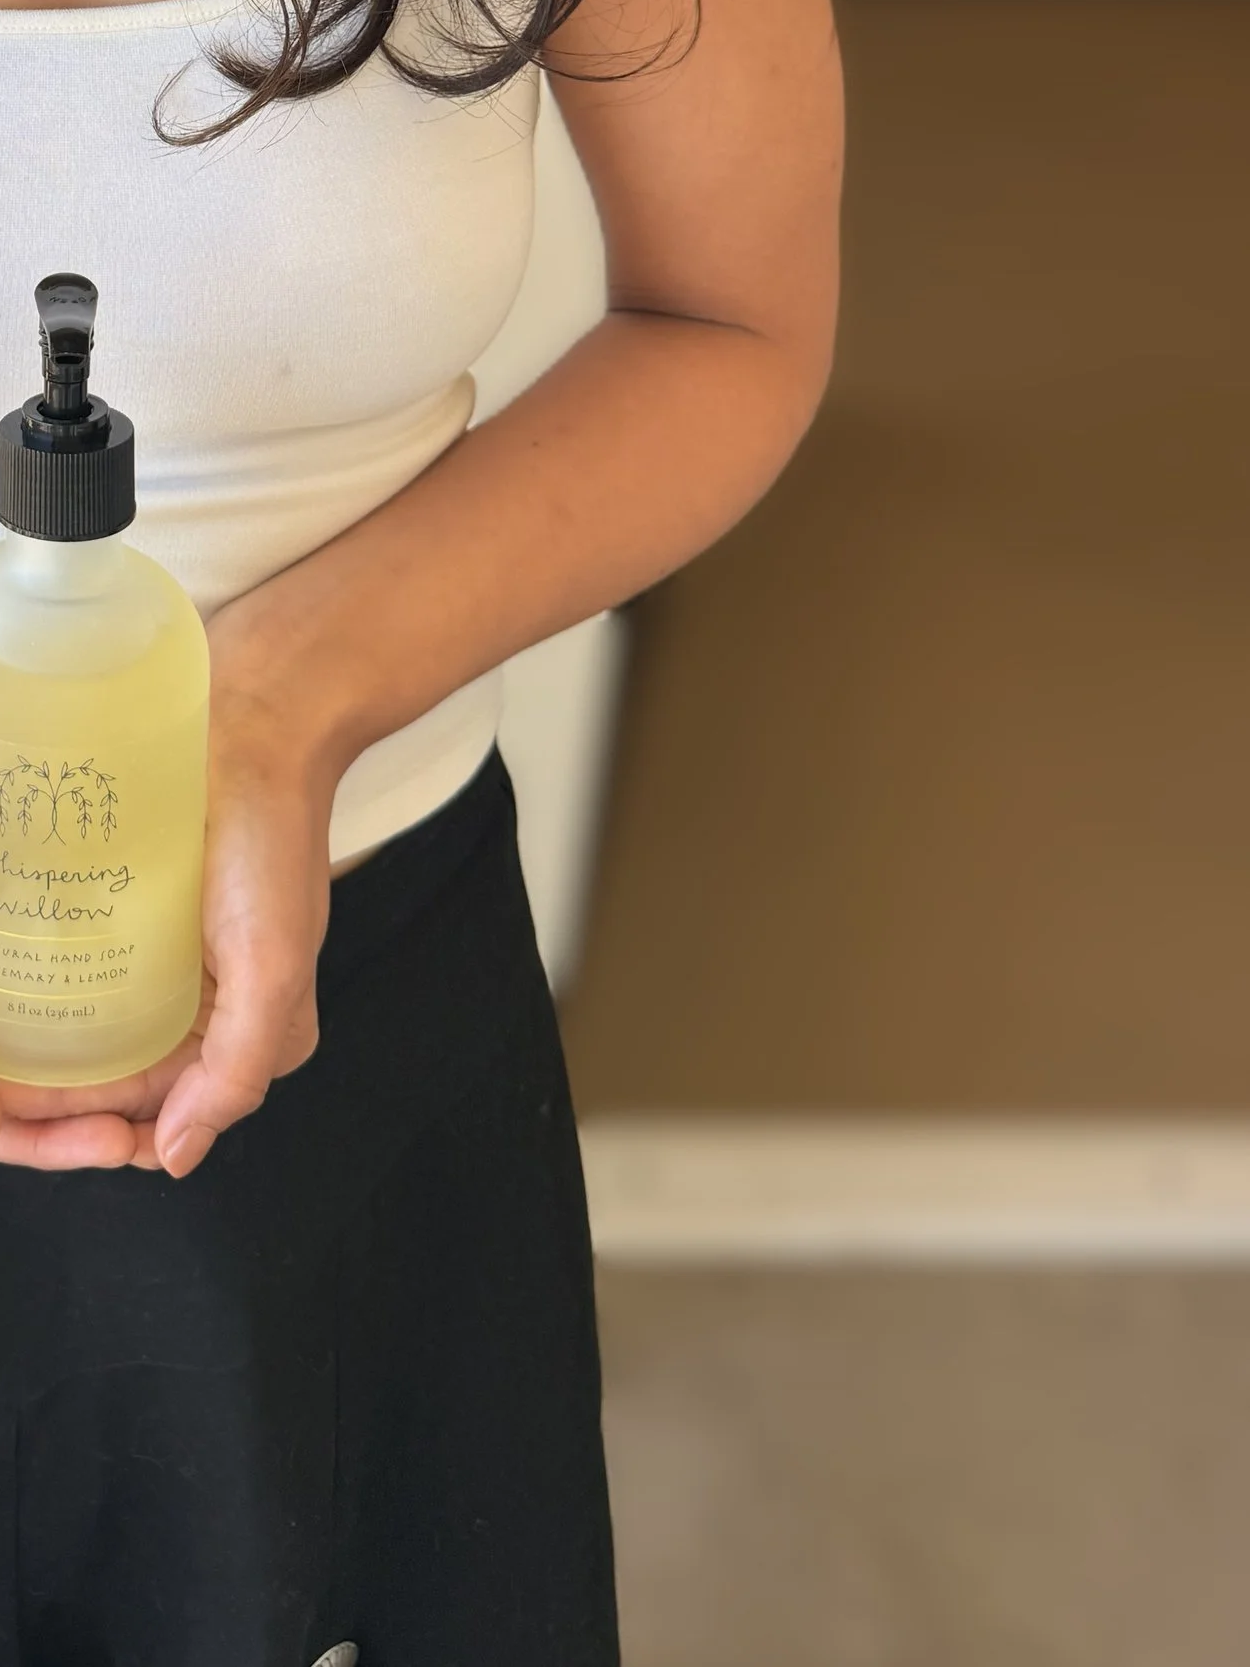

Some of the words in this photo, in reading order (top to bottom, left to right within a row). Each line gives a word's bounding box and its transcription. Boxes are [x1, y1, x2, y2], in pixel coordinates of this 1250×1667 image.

[51, 953, 91, 963] HAND
[100, 944, 135, 962] SOAP
[64, 975, 70, 984] &
[79, 967, 128, 983] LEMON
[7, 1003, 14, 1012] 8
[17, 1003, 26, 1014] fl
[28, 1008, 42, 1016] oz
[46, 1005, 69, 1019] (236
[72, 1005, 95, 1017] mL)
